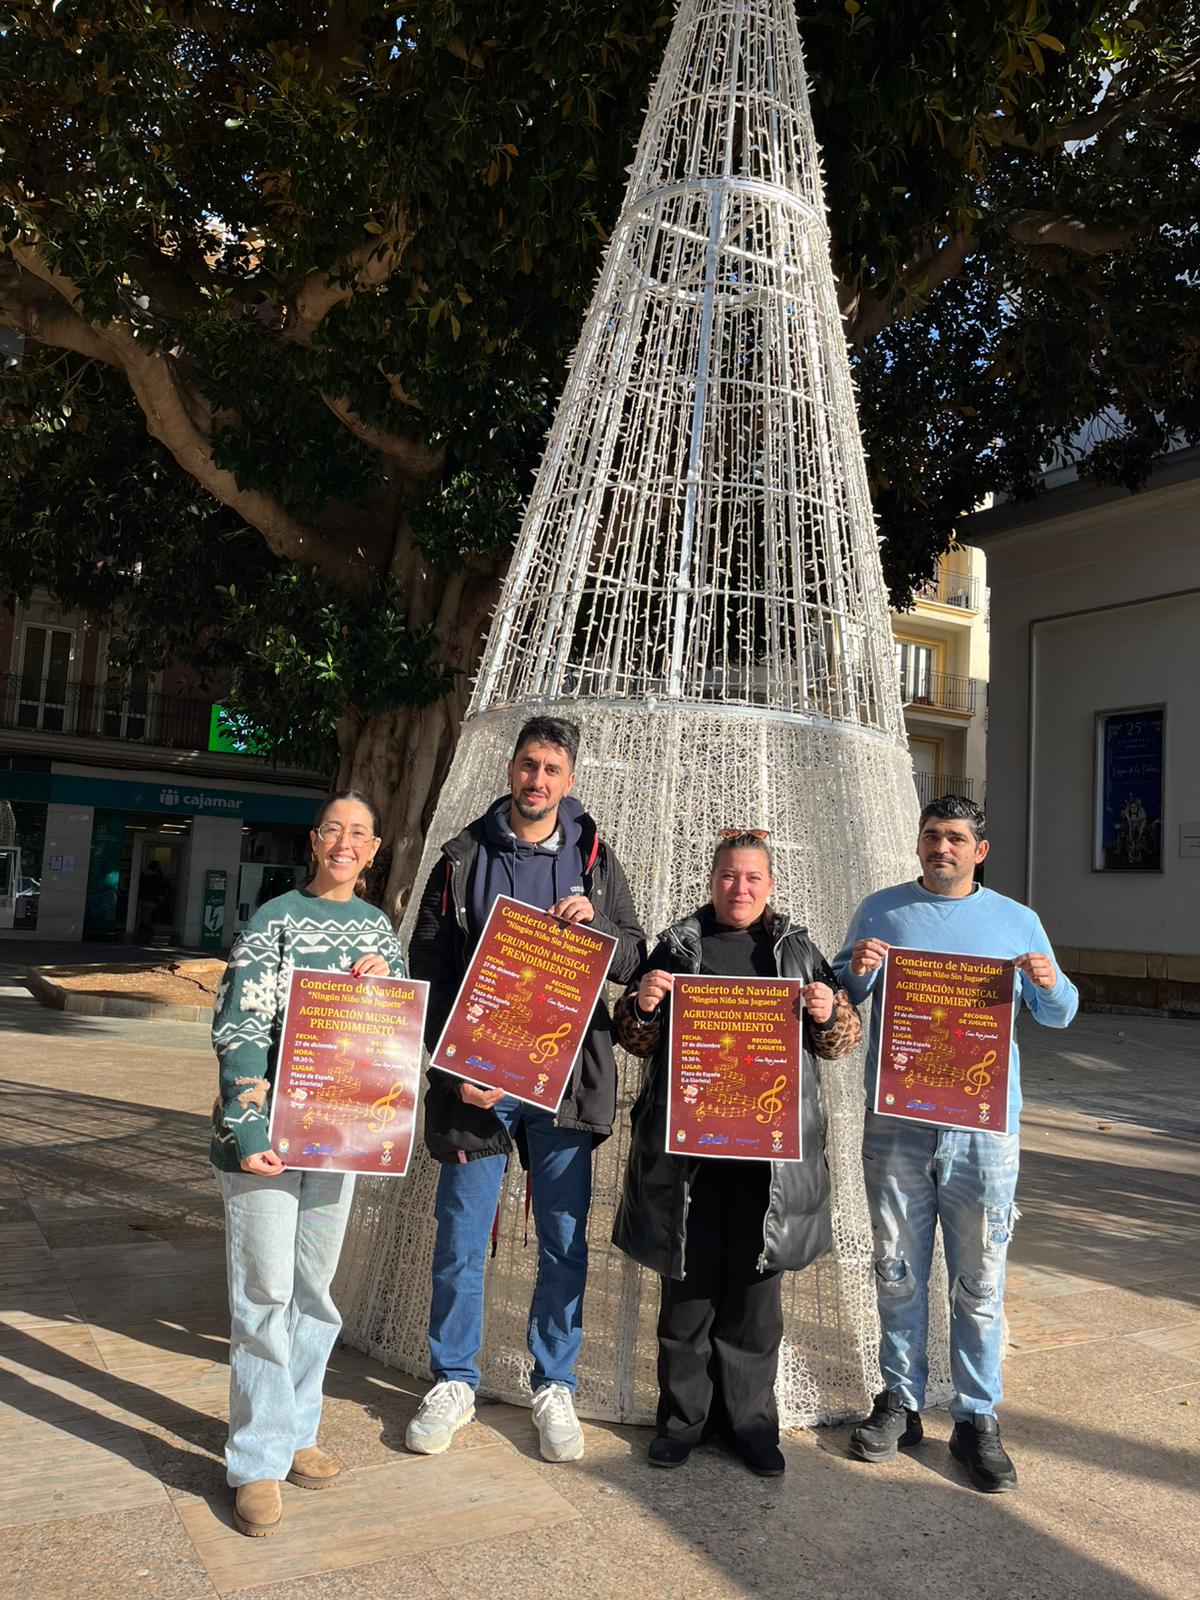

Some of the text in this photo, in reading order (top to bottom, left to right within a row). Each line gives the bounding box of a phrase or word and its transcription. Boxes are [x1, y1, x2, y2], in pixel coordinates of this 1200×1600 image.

[183, 793, 243, 809] cajamar
[502, 906, 603, 951] Concierto de Navidad
[534, 929, 550, 941] Niño
[551, 936, 561, 945] Sin
[494, 932, 591, 974] AGRUPACIÓN MUSICAL
[501, 945, 576, 980] PRENDIMIENTO
[895, 956, 1002, 975] Concierto de Navidad
[933, 971, 949, 979] Niño
[300, 978, 352, 992] Concierto
[370, 985, 415, 1000] Navidad
[552, 979, 580, 993] RECOGIDA
[681, 984, 789, 997] Concierto de Navidad
[896, 981, 998, 999] AGRUPACIÓN MUSICAL
[361, 996, 373, 1004] Sin
[553, 987, 581, 1002] JUGUETES
[906, 992, 985, 1008] PRENDIMIENTO
[299, 1006, 408, 1025] AGRUPACIÓN MUSICAL
[683, 1010, 785, 1021] AGRUPACIÓN MUSICAL
[310, 1019, 395, 1036] PRENDIMIENTO
[694, 1021, 774, 1032] PRENDIMIENTO
